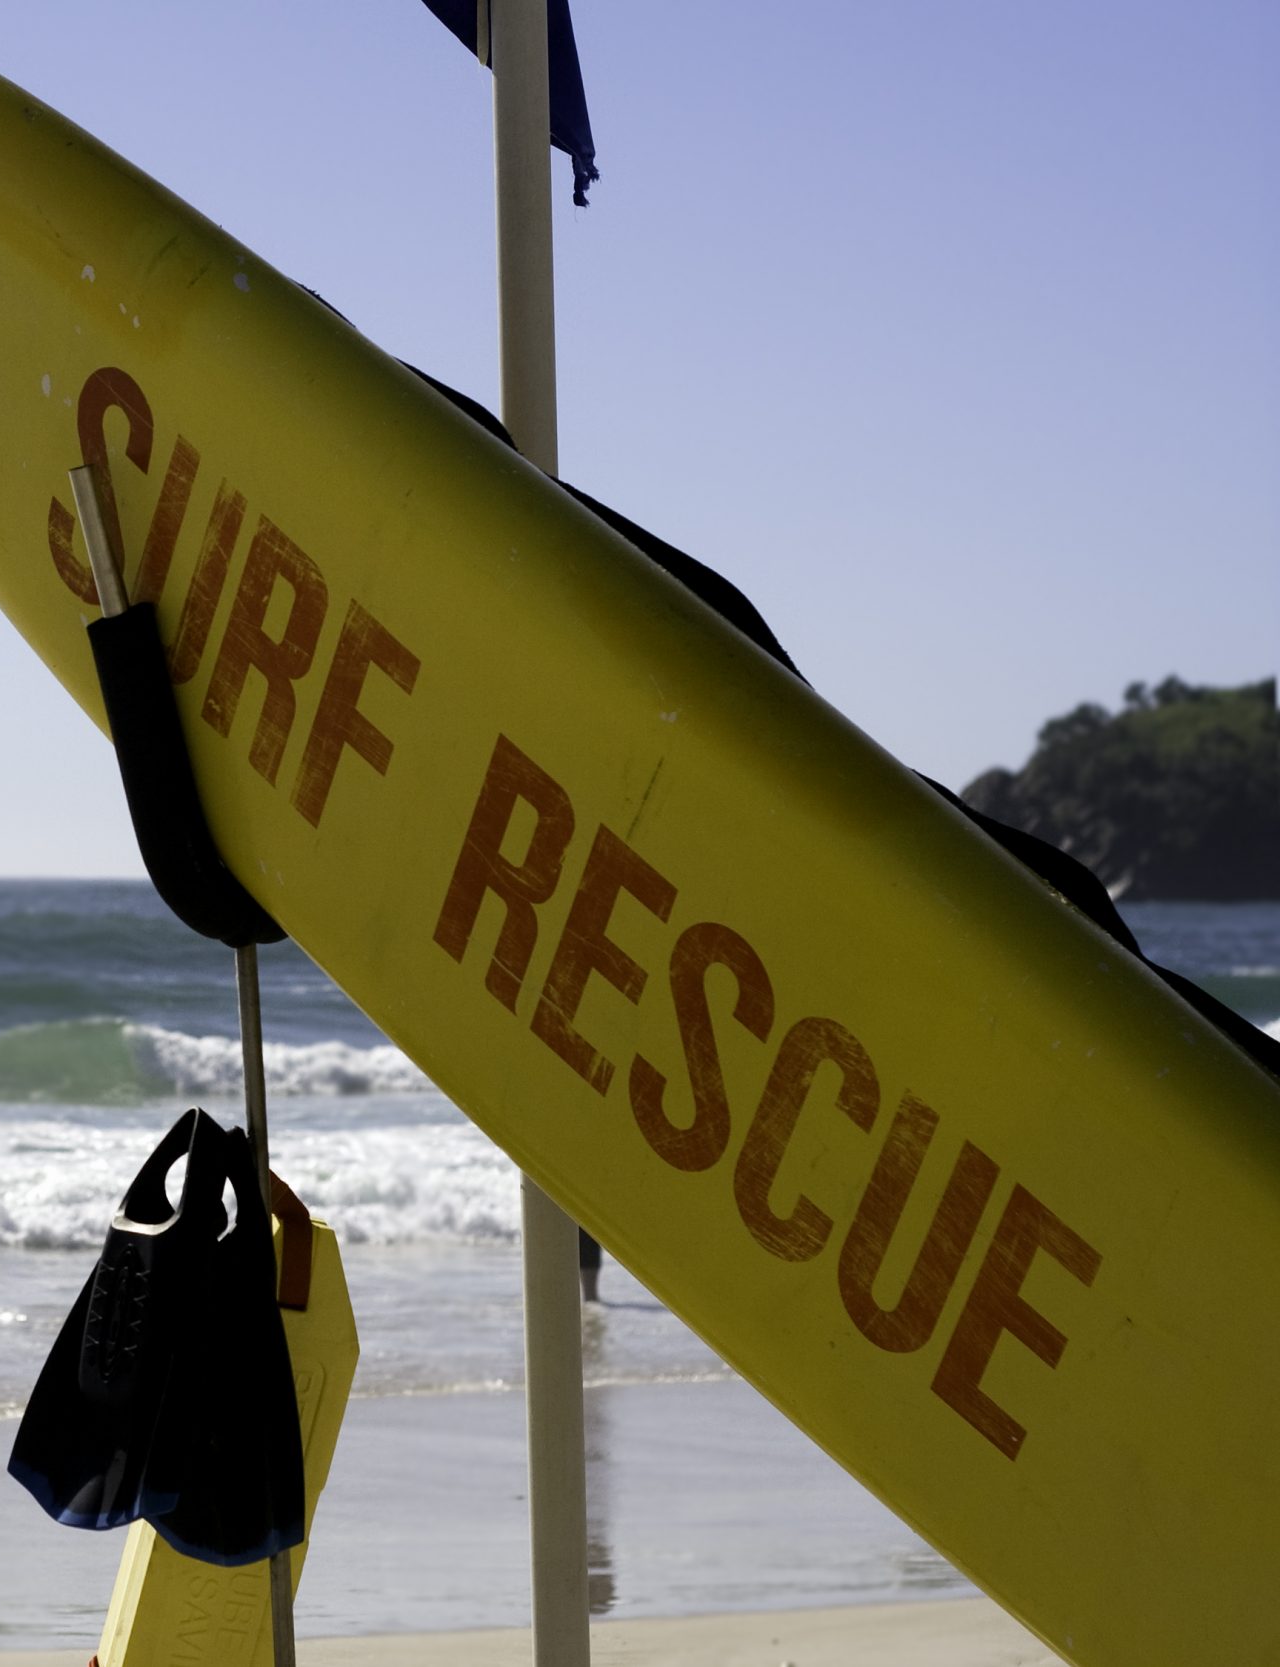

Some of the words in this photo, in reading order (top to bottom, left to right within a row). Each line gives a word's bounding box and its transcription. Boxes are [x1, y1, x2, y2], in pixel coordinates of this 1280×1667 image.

[48, 366, 422, 830] SURF
[432, 732, 1104, 1463] RESCUE
[169, 1574, 220, 1667] SAVI
[216, 1571, 264, 1655] UBE
